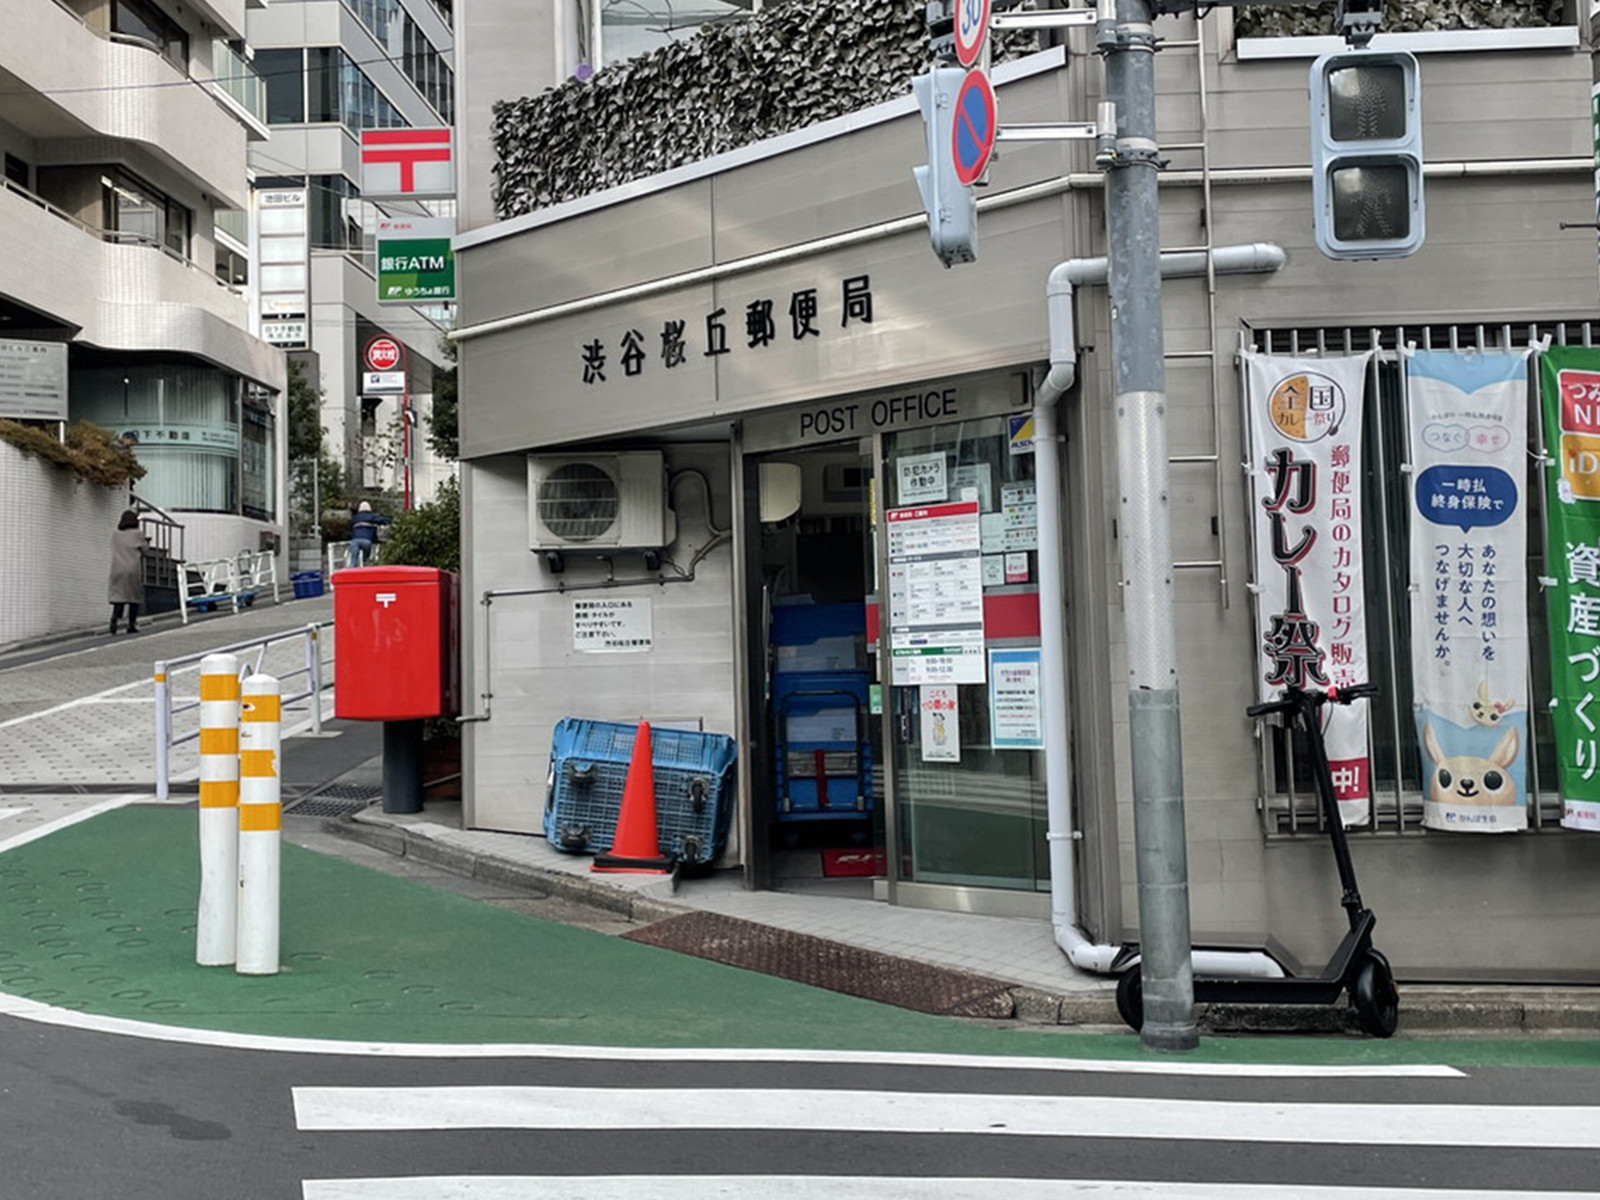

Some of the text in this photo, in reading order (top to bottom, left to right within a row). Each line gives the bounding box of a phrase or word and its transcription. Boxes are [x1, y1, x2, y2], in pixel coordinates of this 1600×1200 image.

[962, 0, 981, 35] 30
[381, 256, 444, 270] 銀行ATM
[581, 275, 874, 385] 渋谷桜丘郵便局
[801, 388, 958, 438] POST OFFICE
[903, 462, 940, 477] 防犯カメラ
[910, 476, 935, 487] 作動中
[1442, 480, 1487, 494] 一時払
[1431, 494, 1504, 511] 終身保険で
[1458, 543, 1474, 625] 大切な人へ
[1435, 544, 1451, 667] つなげませんか。
[1482, 545, 1496, 661] あなたの想いを
[1566, 541, 1600, 781] 資産づくり
[1331, 767, 1359, 794] 中!
